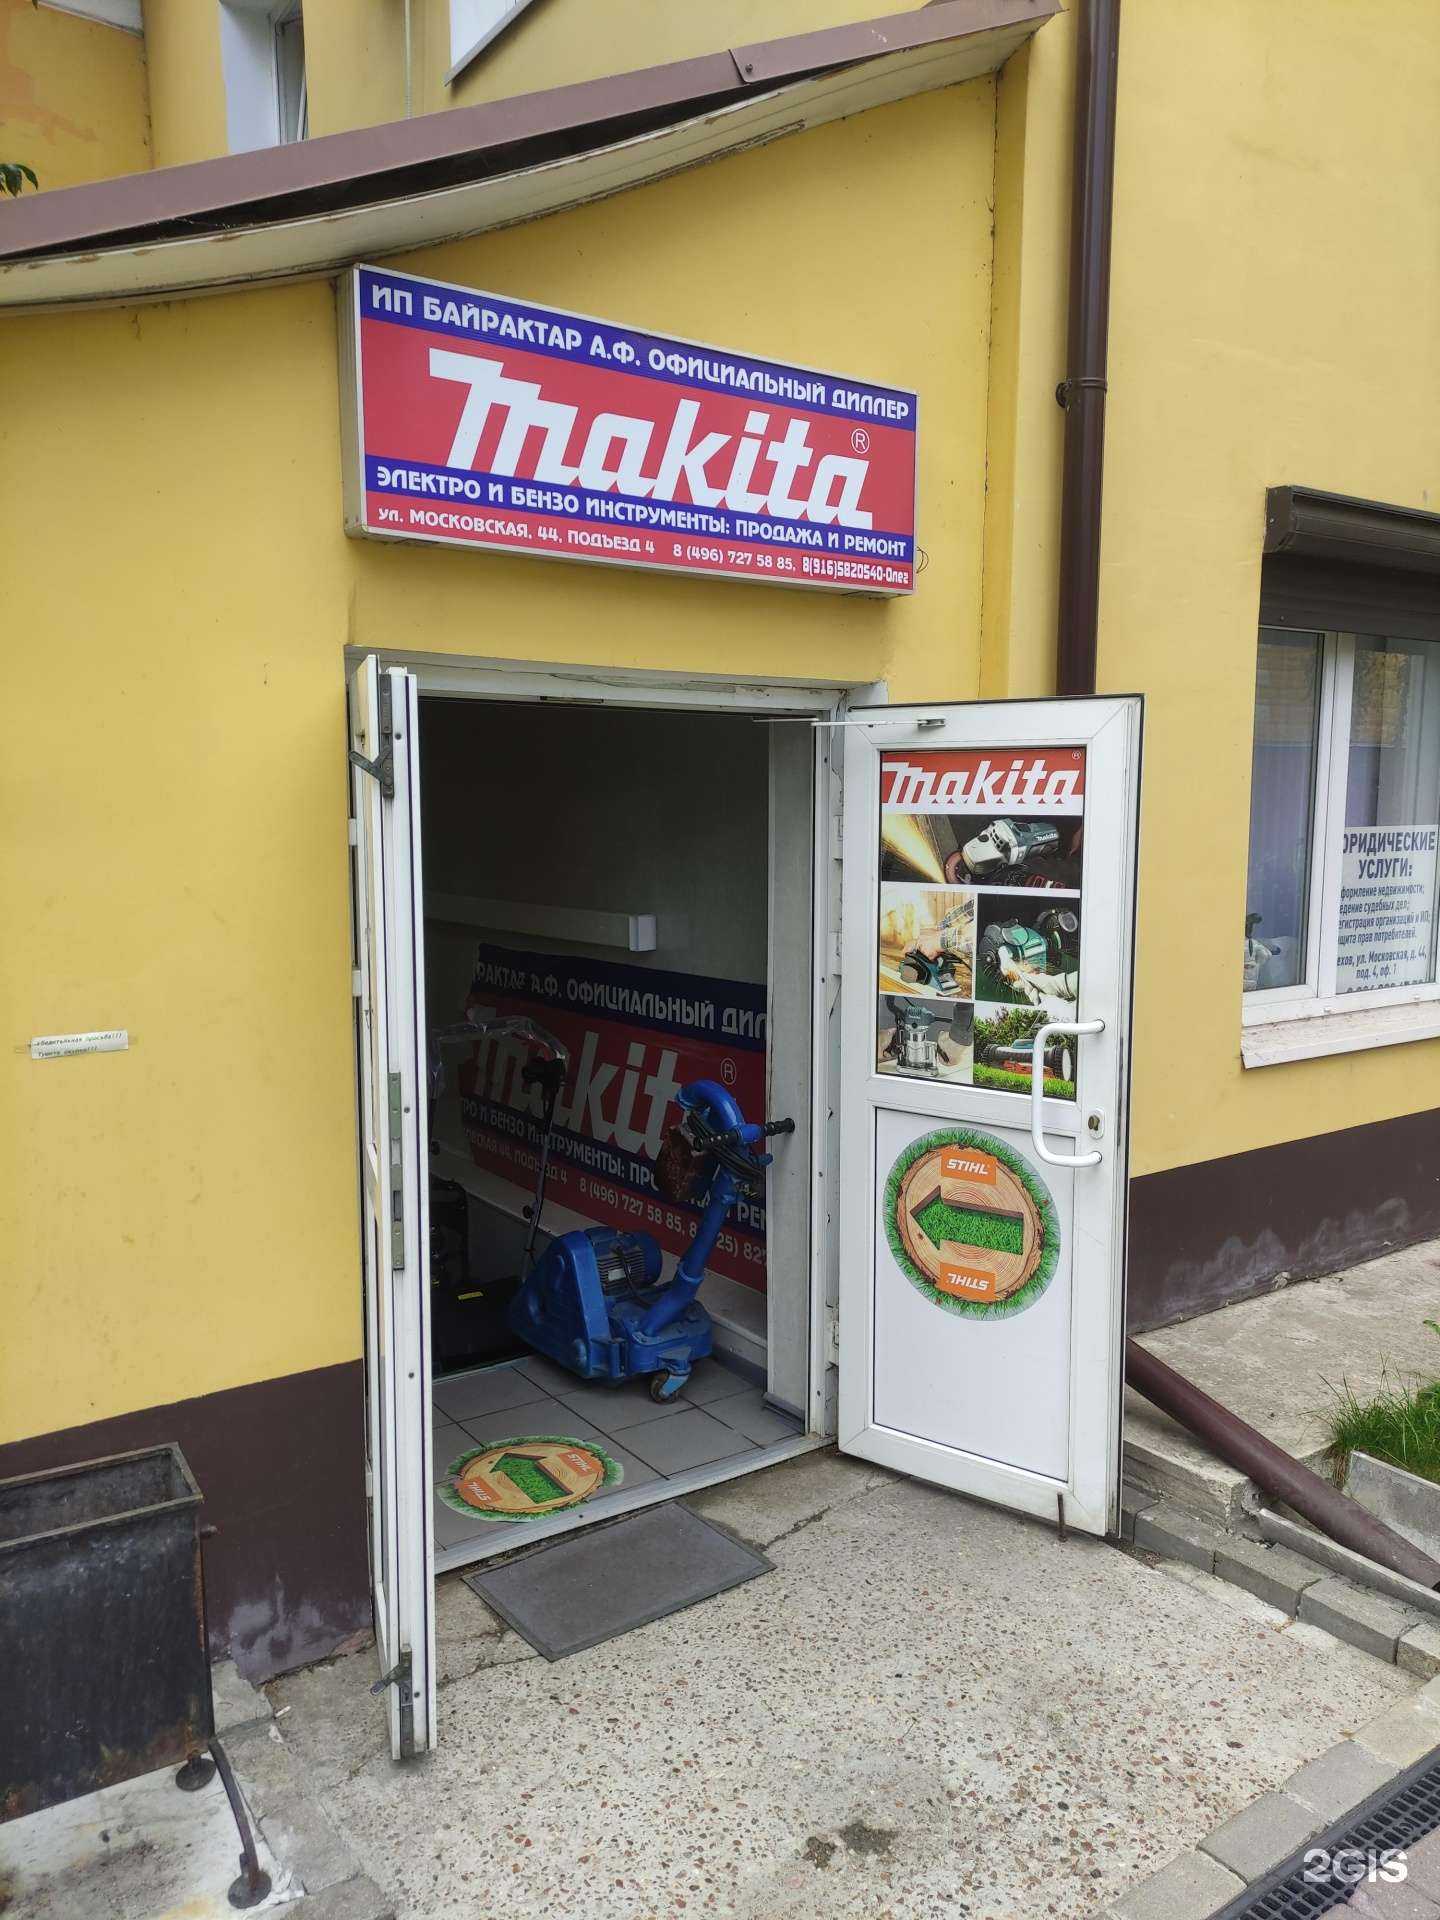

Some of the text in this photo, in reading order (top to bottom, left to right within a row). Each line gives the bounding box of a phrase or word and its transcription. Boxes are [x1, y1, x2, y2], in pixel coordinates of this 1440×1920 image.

[372, 284, 909, 420] ИП БАЙРАКТАР А.Ф. ОФИЦИАЛЬНЫЙ ДИЛЛЕР
[377, 466, 907, 557] ЭЛЕКТРО И БЕНЗО ИНСТРУМЕНТЫ: ПРОДАЖА И РЕМОНТ
[567, 530, 641, 552] ПОДЪЕЗД
[645, 540, 655, 554] 4
[673, 544, 682, 557] 8
[686, 545, 724, 564] (496)
[727, 550, 753, 565] 727
[757, 555, 773, 568] 58
[1358, 858, 1413, 879] УСЛУГИ:
[1358, 933, 1373, 947] прав
[567, 978, 715, 1030] ОФИЦИАЛЬНЫЙ
[946, 1158, 989, 1175] STIHL
[579, 1178, 588, 1194] 8
[590, 1181, 620, 1208] (496)
[622, 1194, 643, 1216] 727
[647, 1201, 664, 1221] 58
[743, 1241, 768, 1268] 82
[947, 1272, 989, 1291] STIHL
[465, 1482, 492, 1502] STIHL
